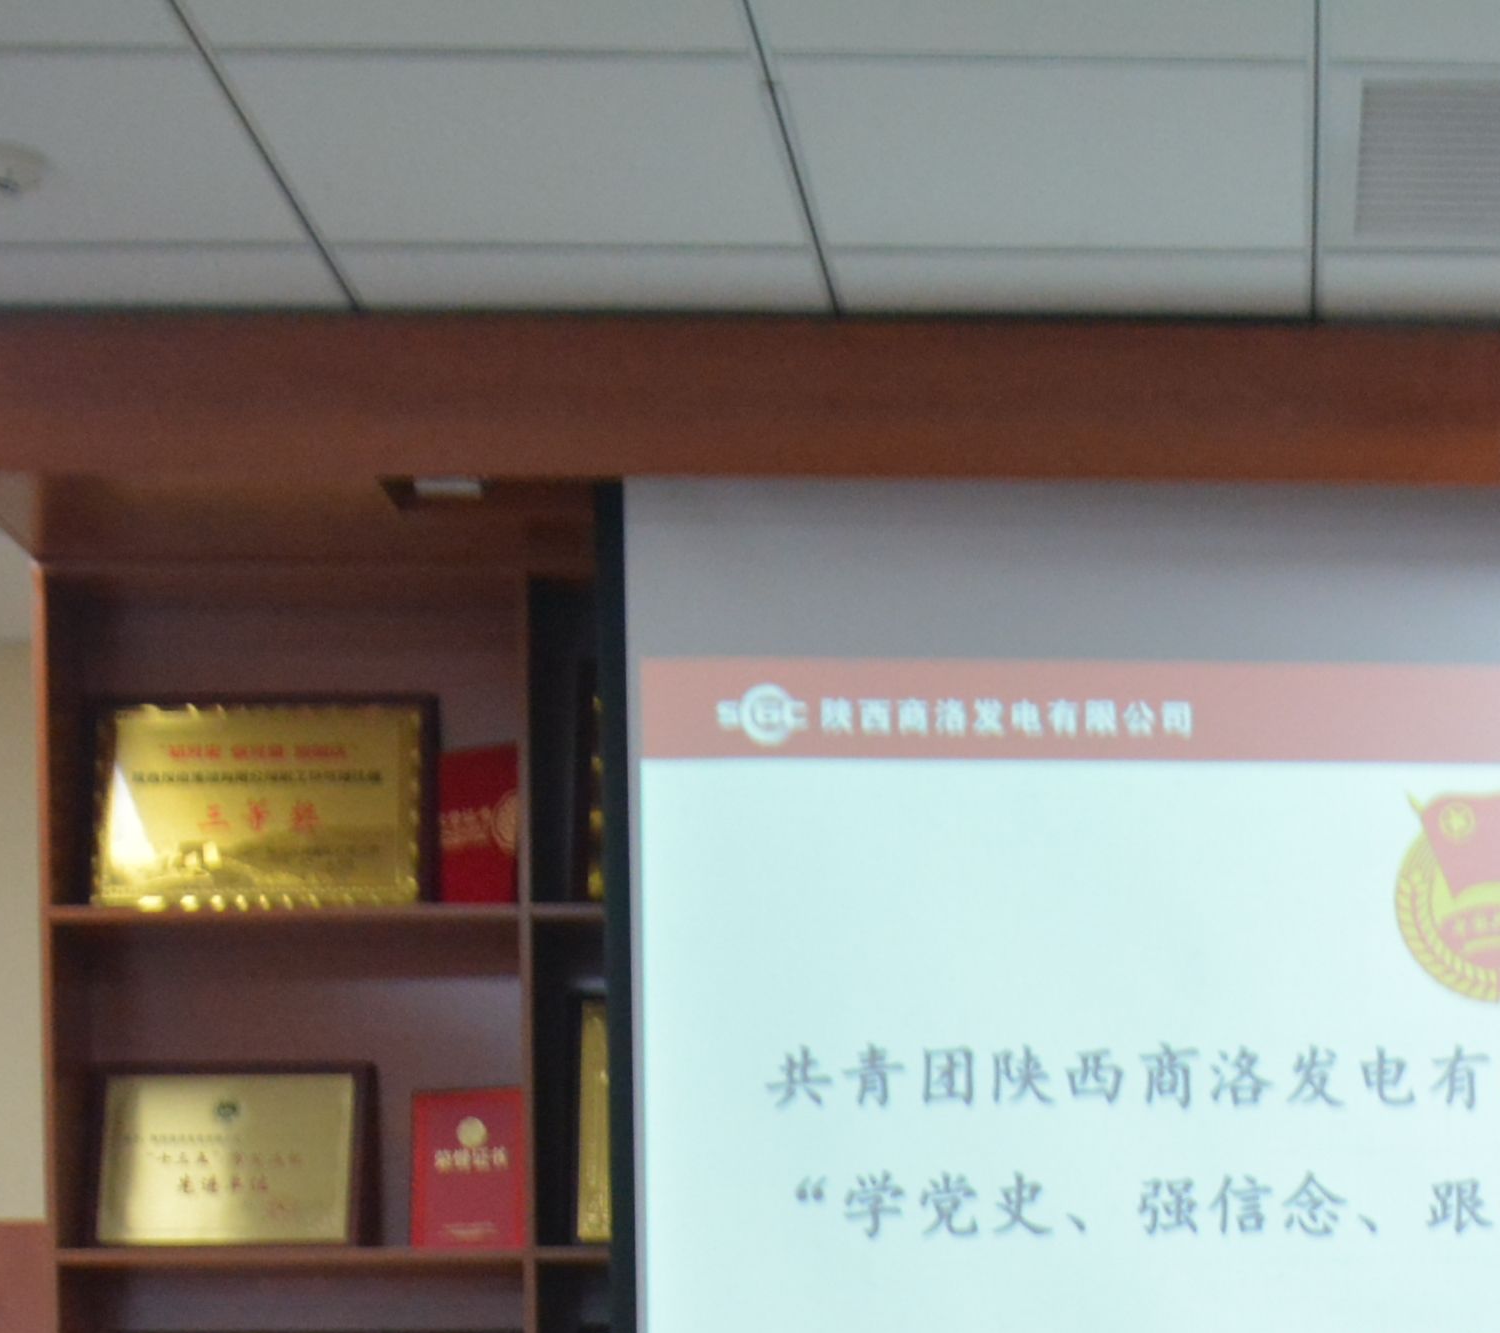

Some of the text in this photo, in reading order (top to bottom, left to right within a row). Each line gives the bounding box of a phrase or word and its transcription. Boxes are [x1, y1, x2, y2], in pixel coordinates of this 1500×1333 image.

[820, 697, 1193, 740] 陕西商洛发电有限公司
[433, 1147, 510, 1173] 荣誉证书
